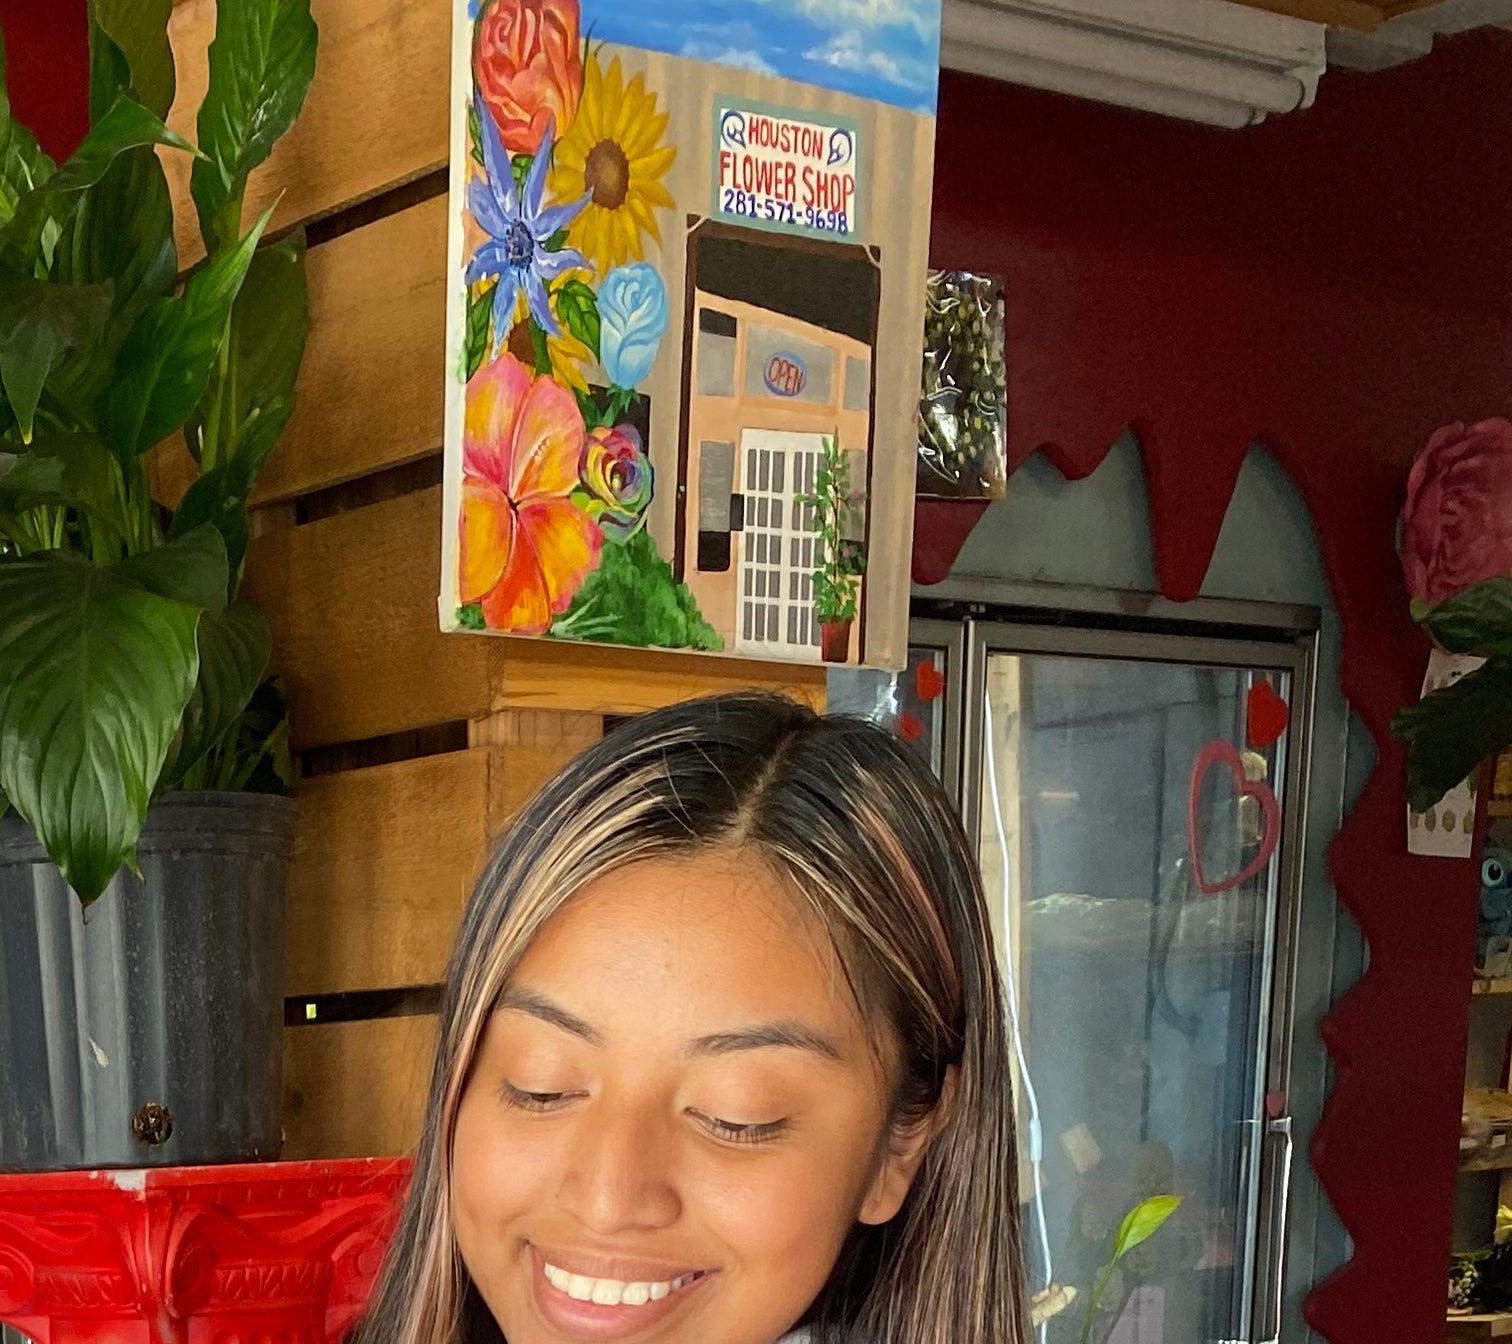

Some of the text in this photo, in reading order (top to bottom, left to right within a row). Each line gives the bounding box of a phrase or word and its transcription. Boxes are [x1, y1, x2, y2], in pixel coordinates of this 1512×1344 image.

[748, 116, 823, 160] HOUSTON
[719, 150, 855, 215] FLOWER SHOP
[724, 188, 848, 235] 281-571-9698
[768, 356, 804, 393] OPEN
